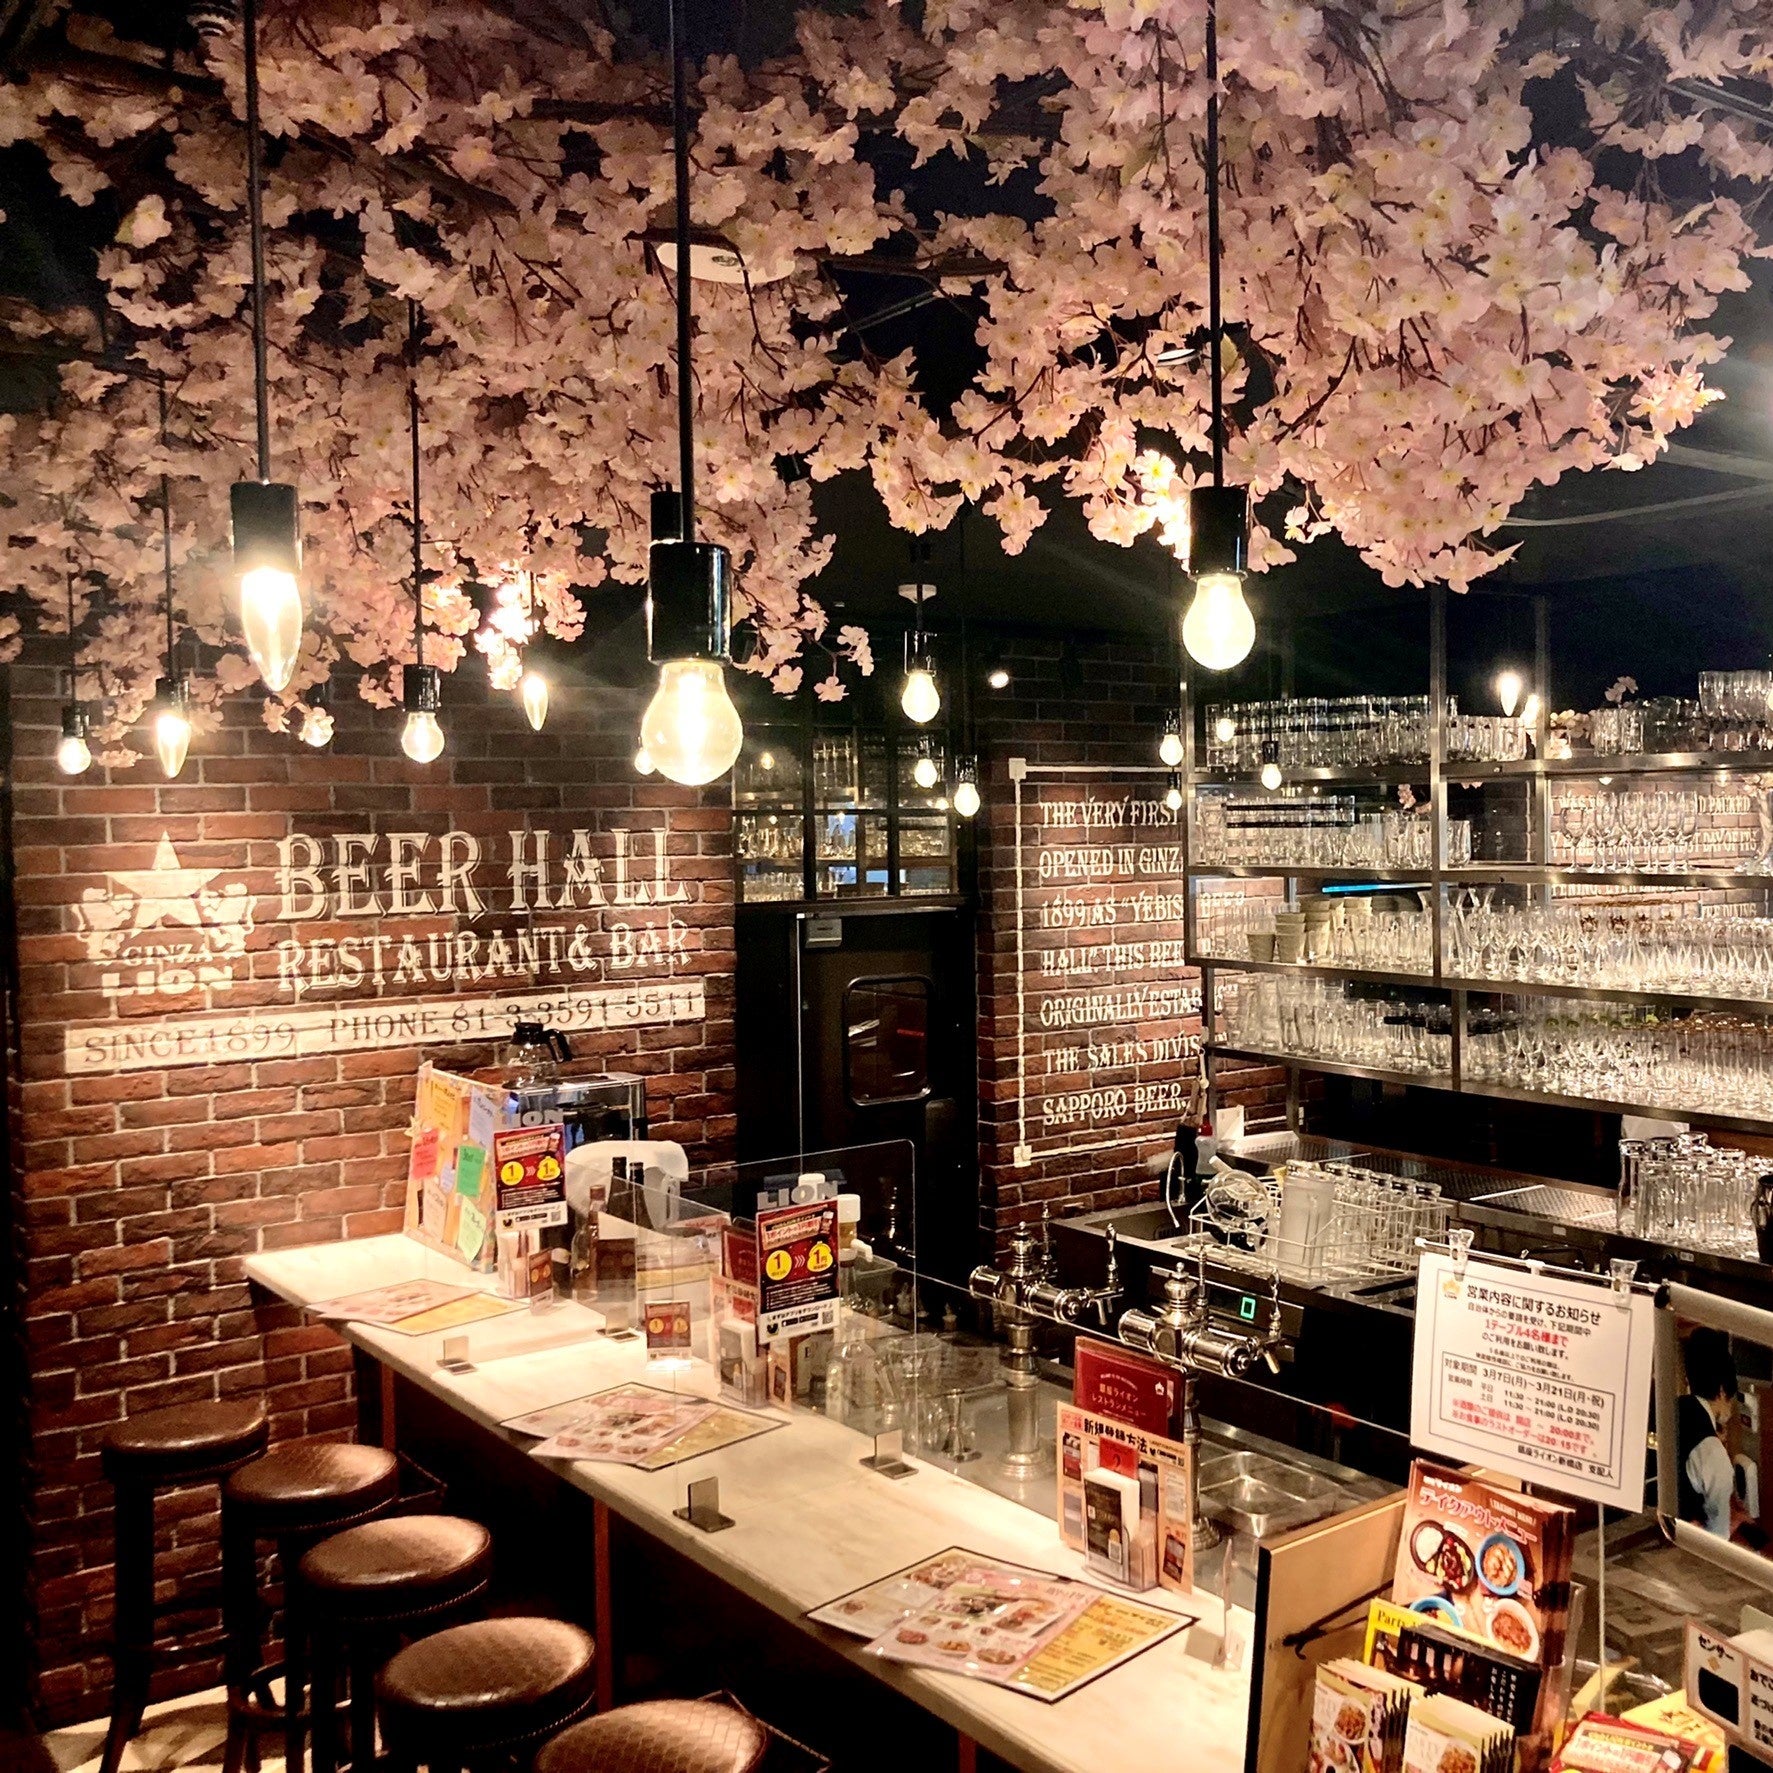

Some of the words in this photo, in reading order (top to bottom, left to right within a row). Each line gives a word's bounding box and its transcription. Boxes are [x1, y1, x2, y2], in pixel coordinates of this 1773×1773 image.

[1039, 801, 1077, 828] THE
[1080, 795, 1130, 829] VERY
[274, 830, 489, 922] BEER
[508, 827, 693, 912] HALL
[1038, 849, 1114, 878] OPENED
[1118, 848, 1136, 875] IN
[1139, 847, 1184, 873] GINZ
[1041, 894, 1087, 927] 1899
[1090, 897, 1117, 925] AS
[122, 944, 214, 966] GINZA
[610, 919, 692, 971] BAR
[1099, 943, 1145, 972] THIS
[1149, 940, 1185, 968] BEE
[102, 966, 233, 998] LION
[1040, 986, 1149, 1027] ORIGINALLY
[85, 1029, 198, 1064] SINCE
[206, 1019, 296, 1055] 1899
[330, 1010, 438, 1042] PHONE
[1043, 1046, 1081, 1073] THE
[1087, 1039, 1149, 1072] SALES
[1043, 1088, 1128, 1126] SAPPORO
[757, 1180, 839, 1210] LION
[1467, 1285, 1602, 1327] 営業内容に関するお知らせ
[1485, 1319, 1570, 1348] 1テーブル4名様まで
[1444, 1358, 1478, 1376] 対象期間
[1419, 1486, 1538, 1545] テイクアウトメニュー
[1698, 1634, 1735, 1661] センサー
